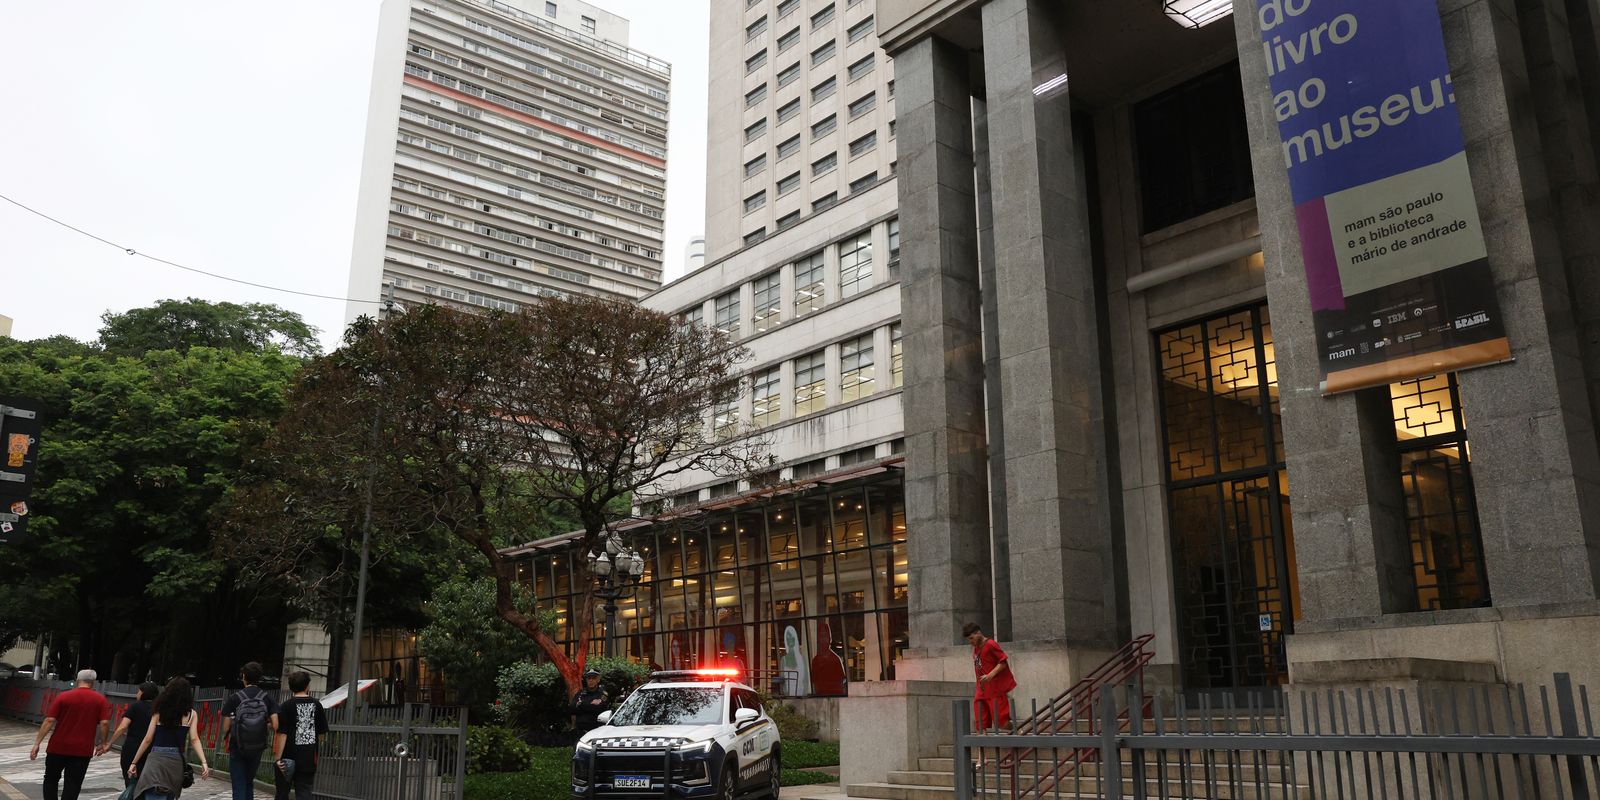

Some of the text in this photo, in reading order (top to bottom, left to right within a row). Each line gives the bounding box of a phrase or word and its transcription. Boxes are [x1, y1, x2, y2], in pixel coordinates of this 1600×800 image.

[1258, 0, 1312, 31] do
[1263, 13, 1358, 77] livro
[1273, 77, 1326, 122] ao
[1282, 73, 1456, 169] museu:
[1344, 191, 1444, 233] mam são paulo
[1348, 212, 1434, 249] e a biblioteca
[1351, 219, 1467, 265] mário de andrade
[1387, 312, 1407, 325] IBM
[1454, 313, 1490, 330] BRASIL
[1328, 347, 1356, 361] mam
[742, 737, 755, 757] GCM
